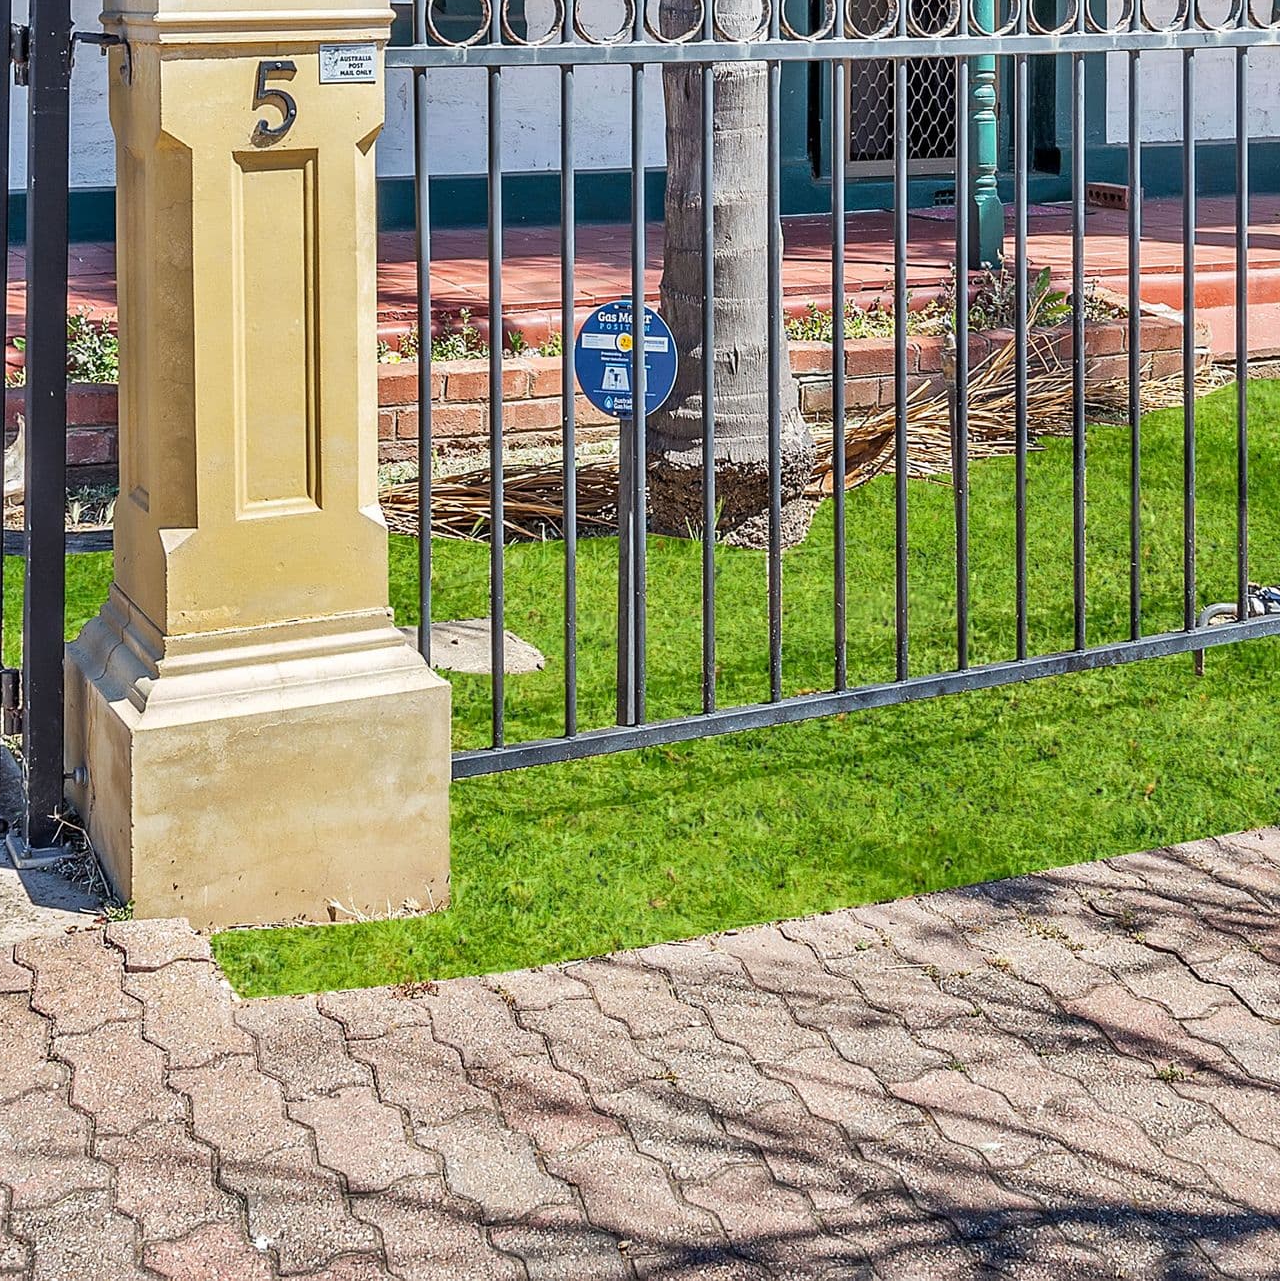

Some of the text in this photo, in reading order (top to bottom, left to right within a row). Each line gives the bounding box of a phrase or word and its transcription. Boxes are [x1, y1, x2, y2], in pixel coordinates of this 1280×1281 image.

[255, 60, 297, 137] 5
[598, 312, 652, 324] Gas Mer
[599, 323, 650, 331] POSITN
